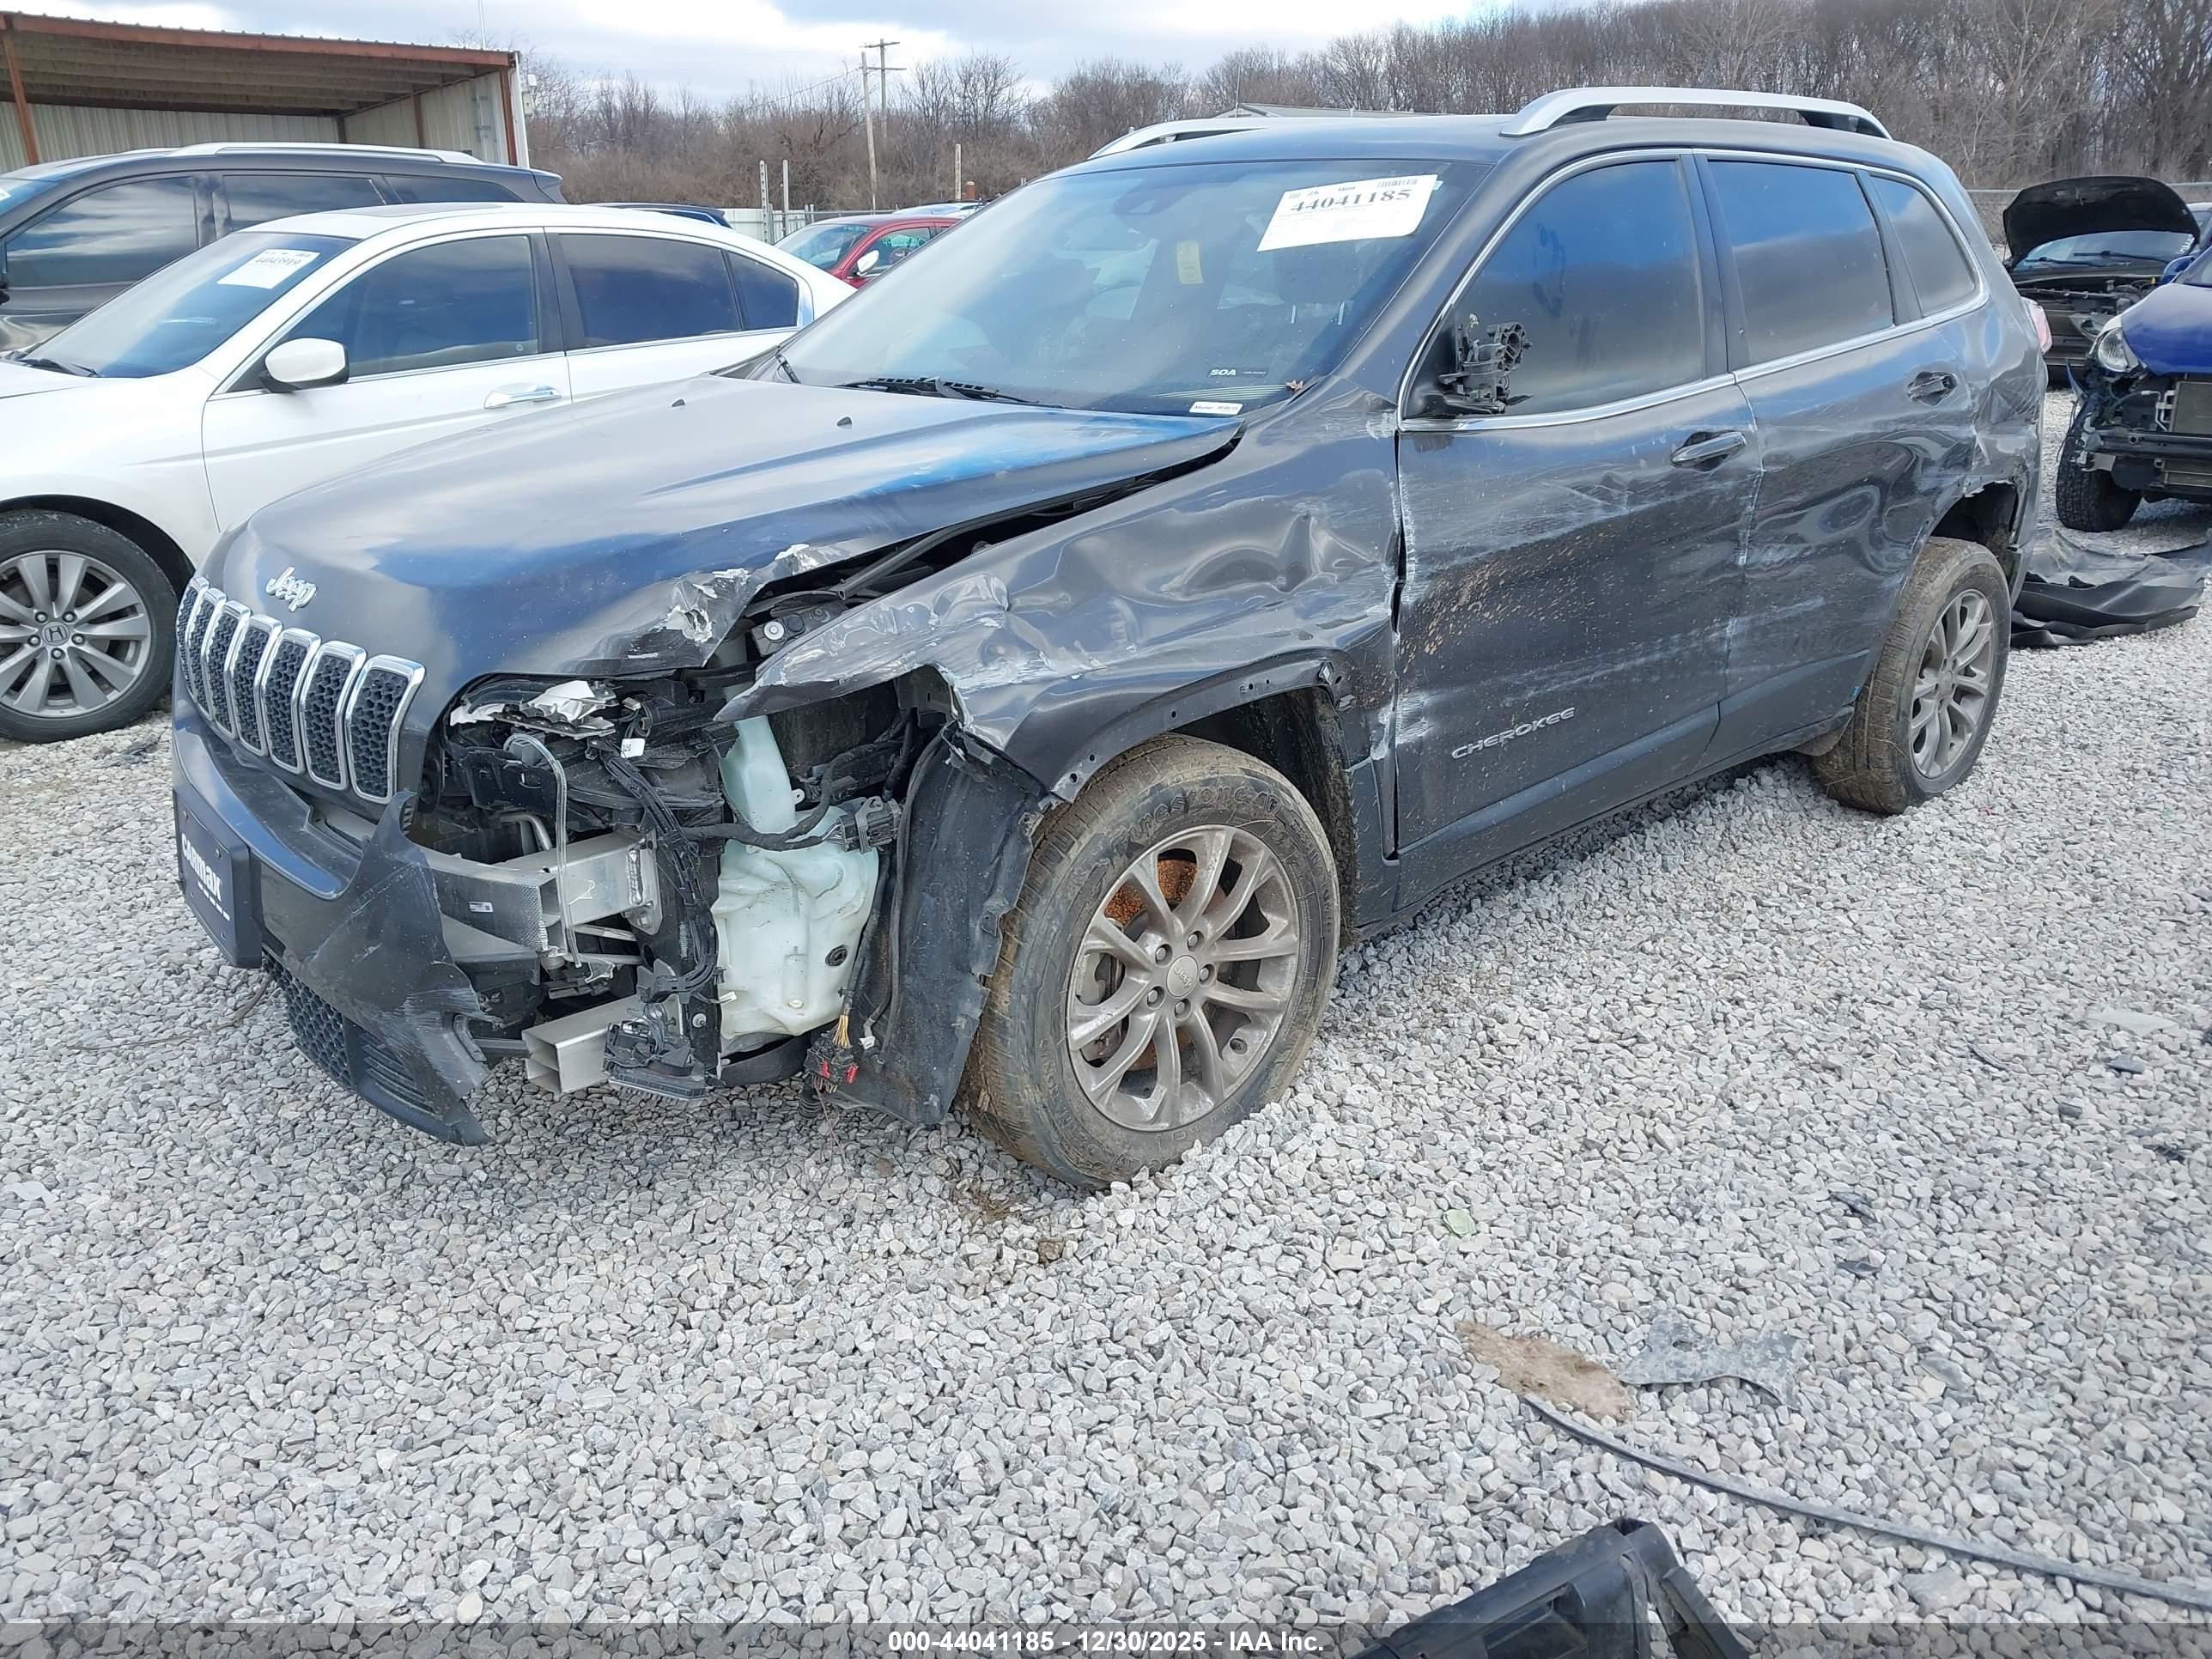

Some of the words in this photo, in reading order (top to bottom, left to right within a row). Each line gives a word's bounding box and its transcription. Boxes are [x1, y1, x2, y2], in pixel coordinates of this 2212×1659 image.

[1291, 189, 1411, 212] 44041185
[265, 566, 318, 612] Jeep
[1451, 707, 1576, 759] CHEROKEE
